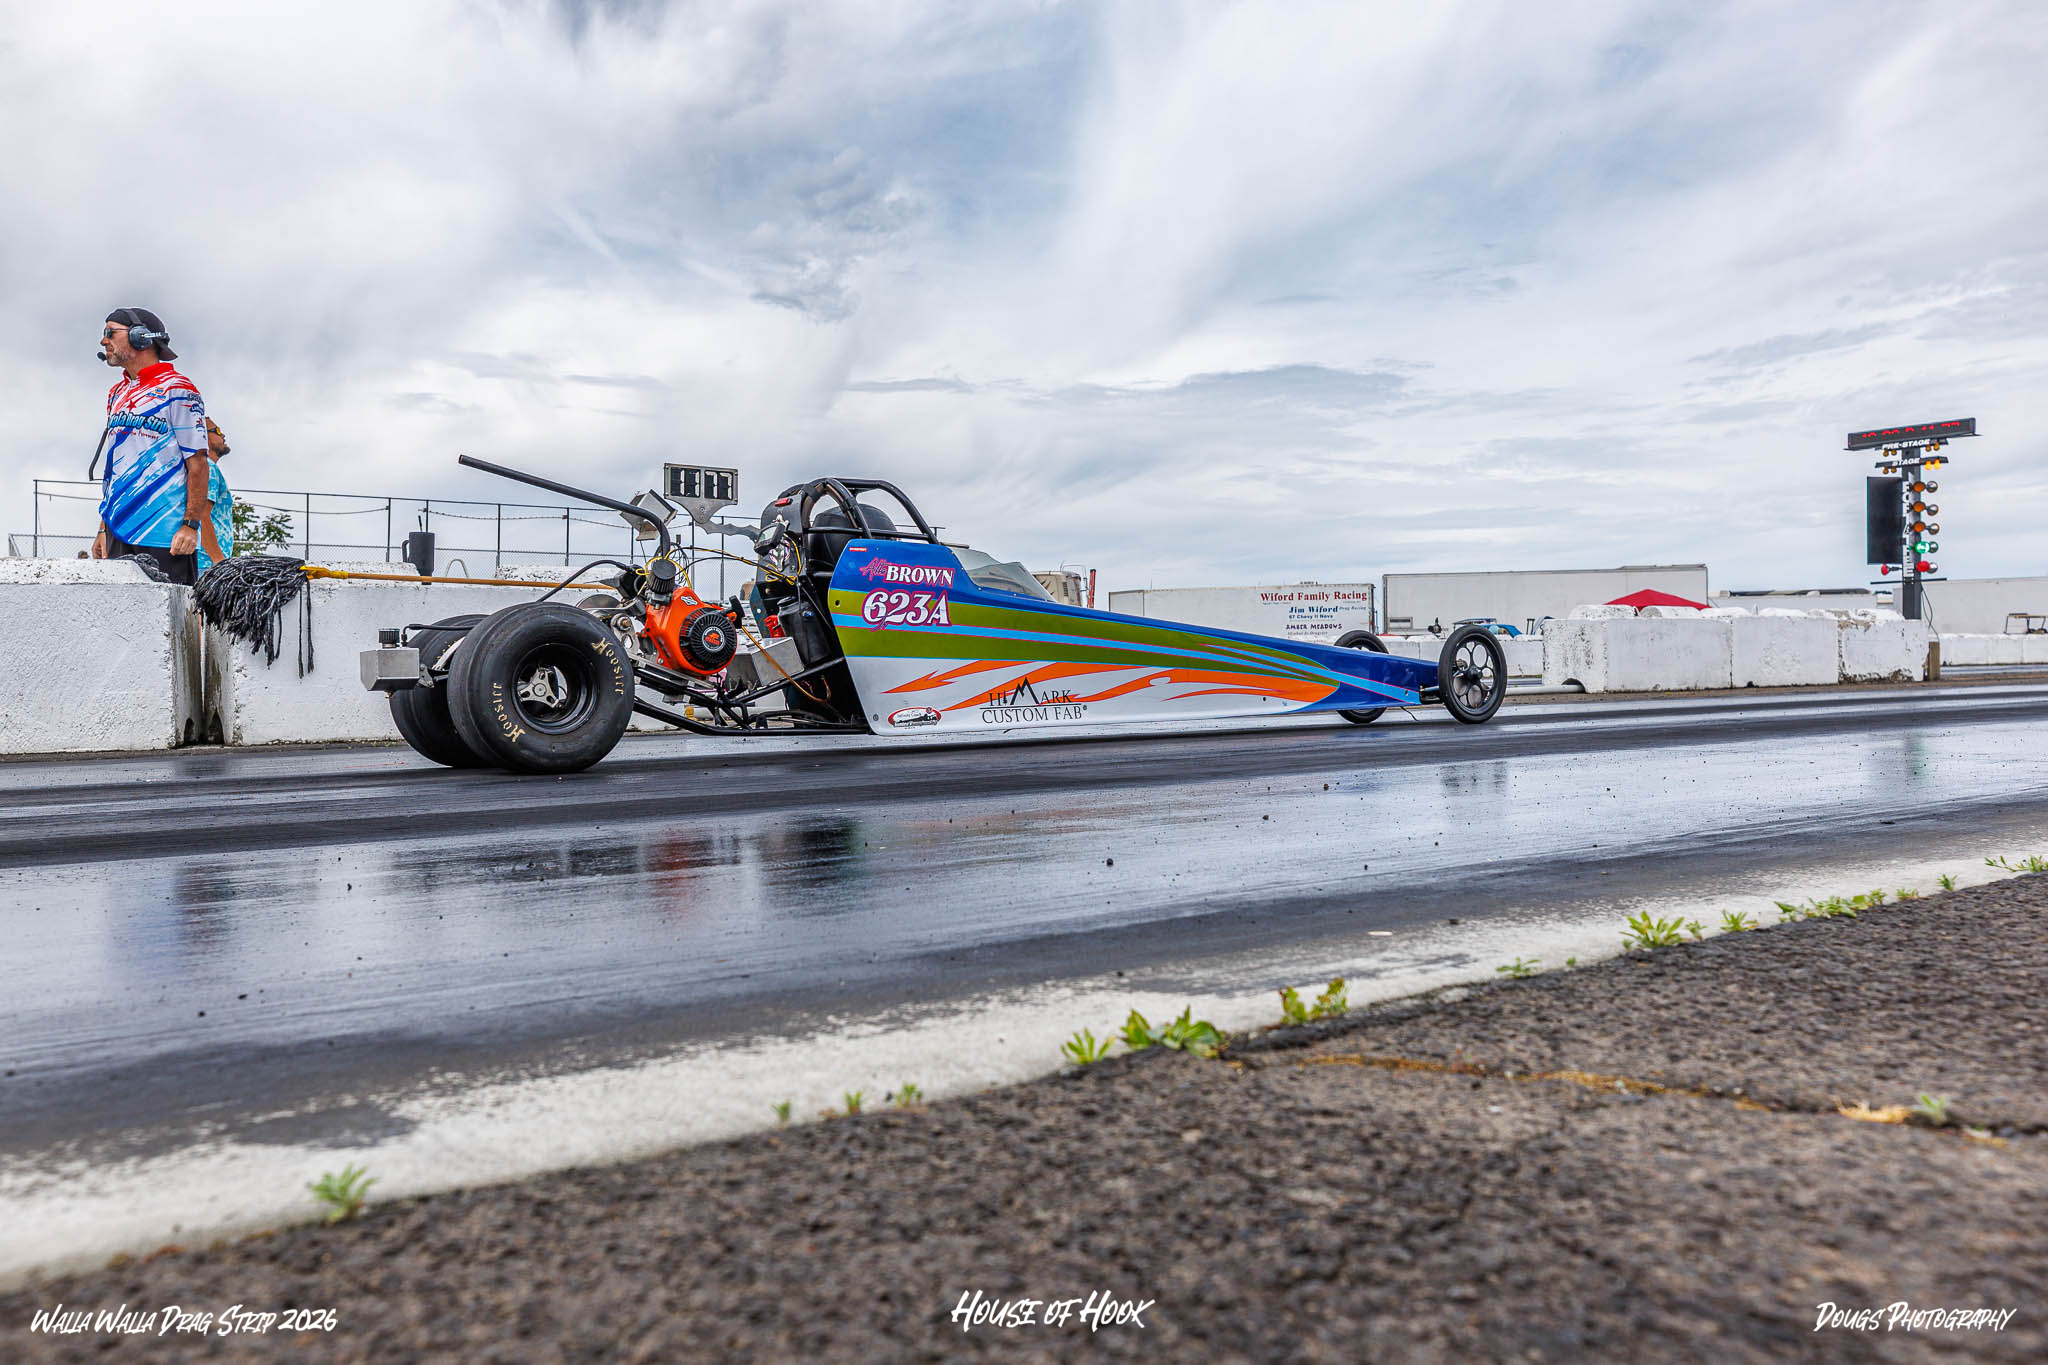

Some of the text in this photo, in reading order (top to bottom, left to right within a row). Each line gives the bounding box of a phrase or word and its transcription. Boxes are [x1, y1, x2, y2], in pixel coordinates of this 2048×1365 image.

[1882, 438, 1931, 450] PRE-STAGE
[1892, 458, 1921, 467] STAGE
[884, 564, 954, 588] BROWN
[1260, 590, 1367, 602] Wiford Family Racing
[863, 589, 952, 627] 623A
[1288, 605, 1339, 614] Jim Wiford
[591, 637, 625, 695] Hoosier
[492, 682, 526, 742] Hoosier
[982, 705, 1082, 724] CUSTOM FAB
